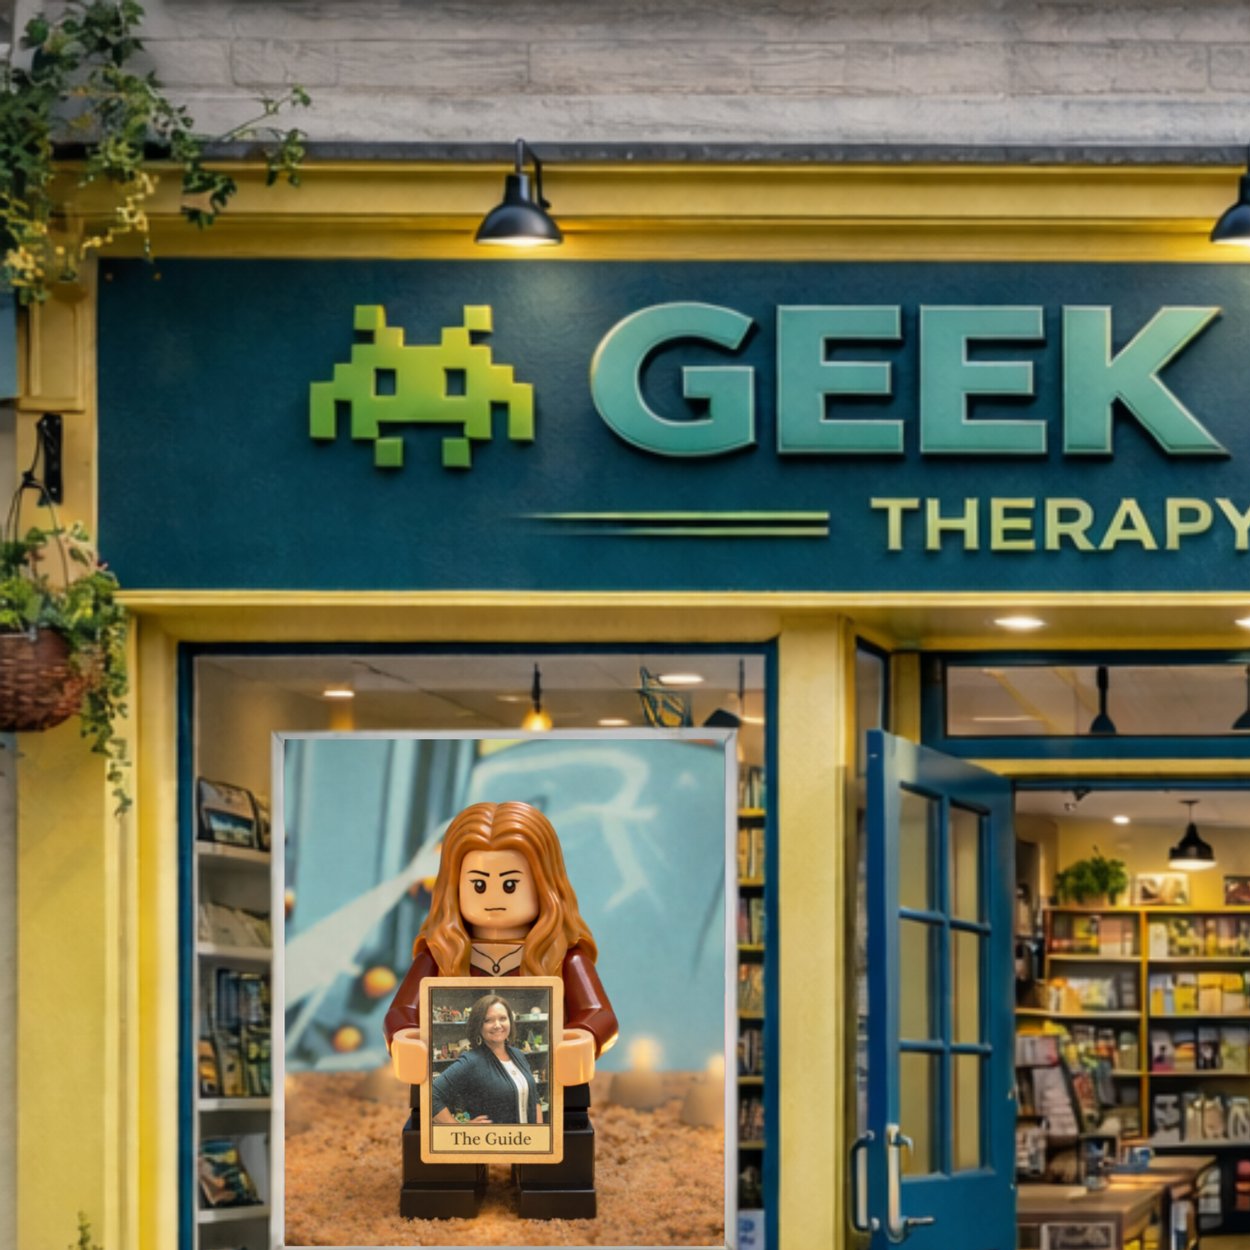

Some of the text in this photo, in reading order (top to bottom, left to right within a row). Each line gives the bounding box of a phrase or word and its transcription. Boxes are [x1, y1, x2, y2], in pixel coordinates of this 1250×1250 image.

[590, 302, 1230, 458] GEEK
[451, 1131, 532, 1146] The Guide
